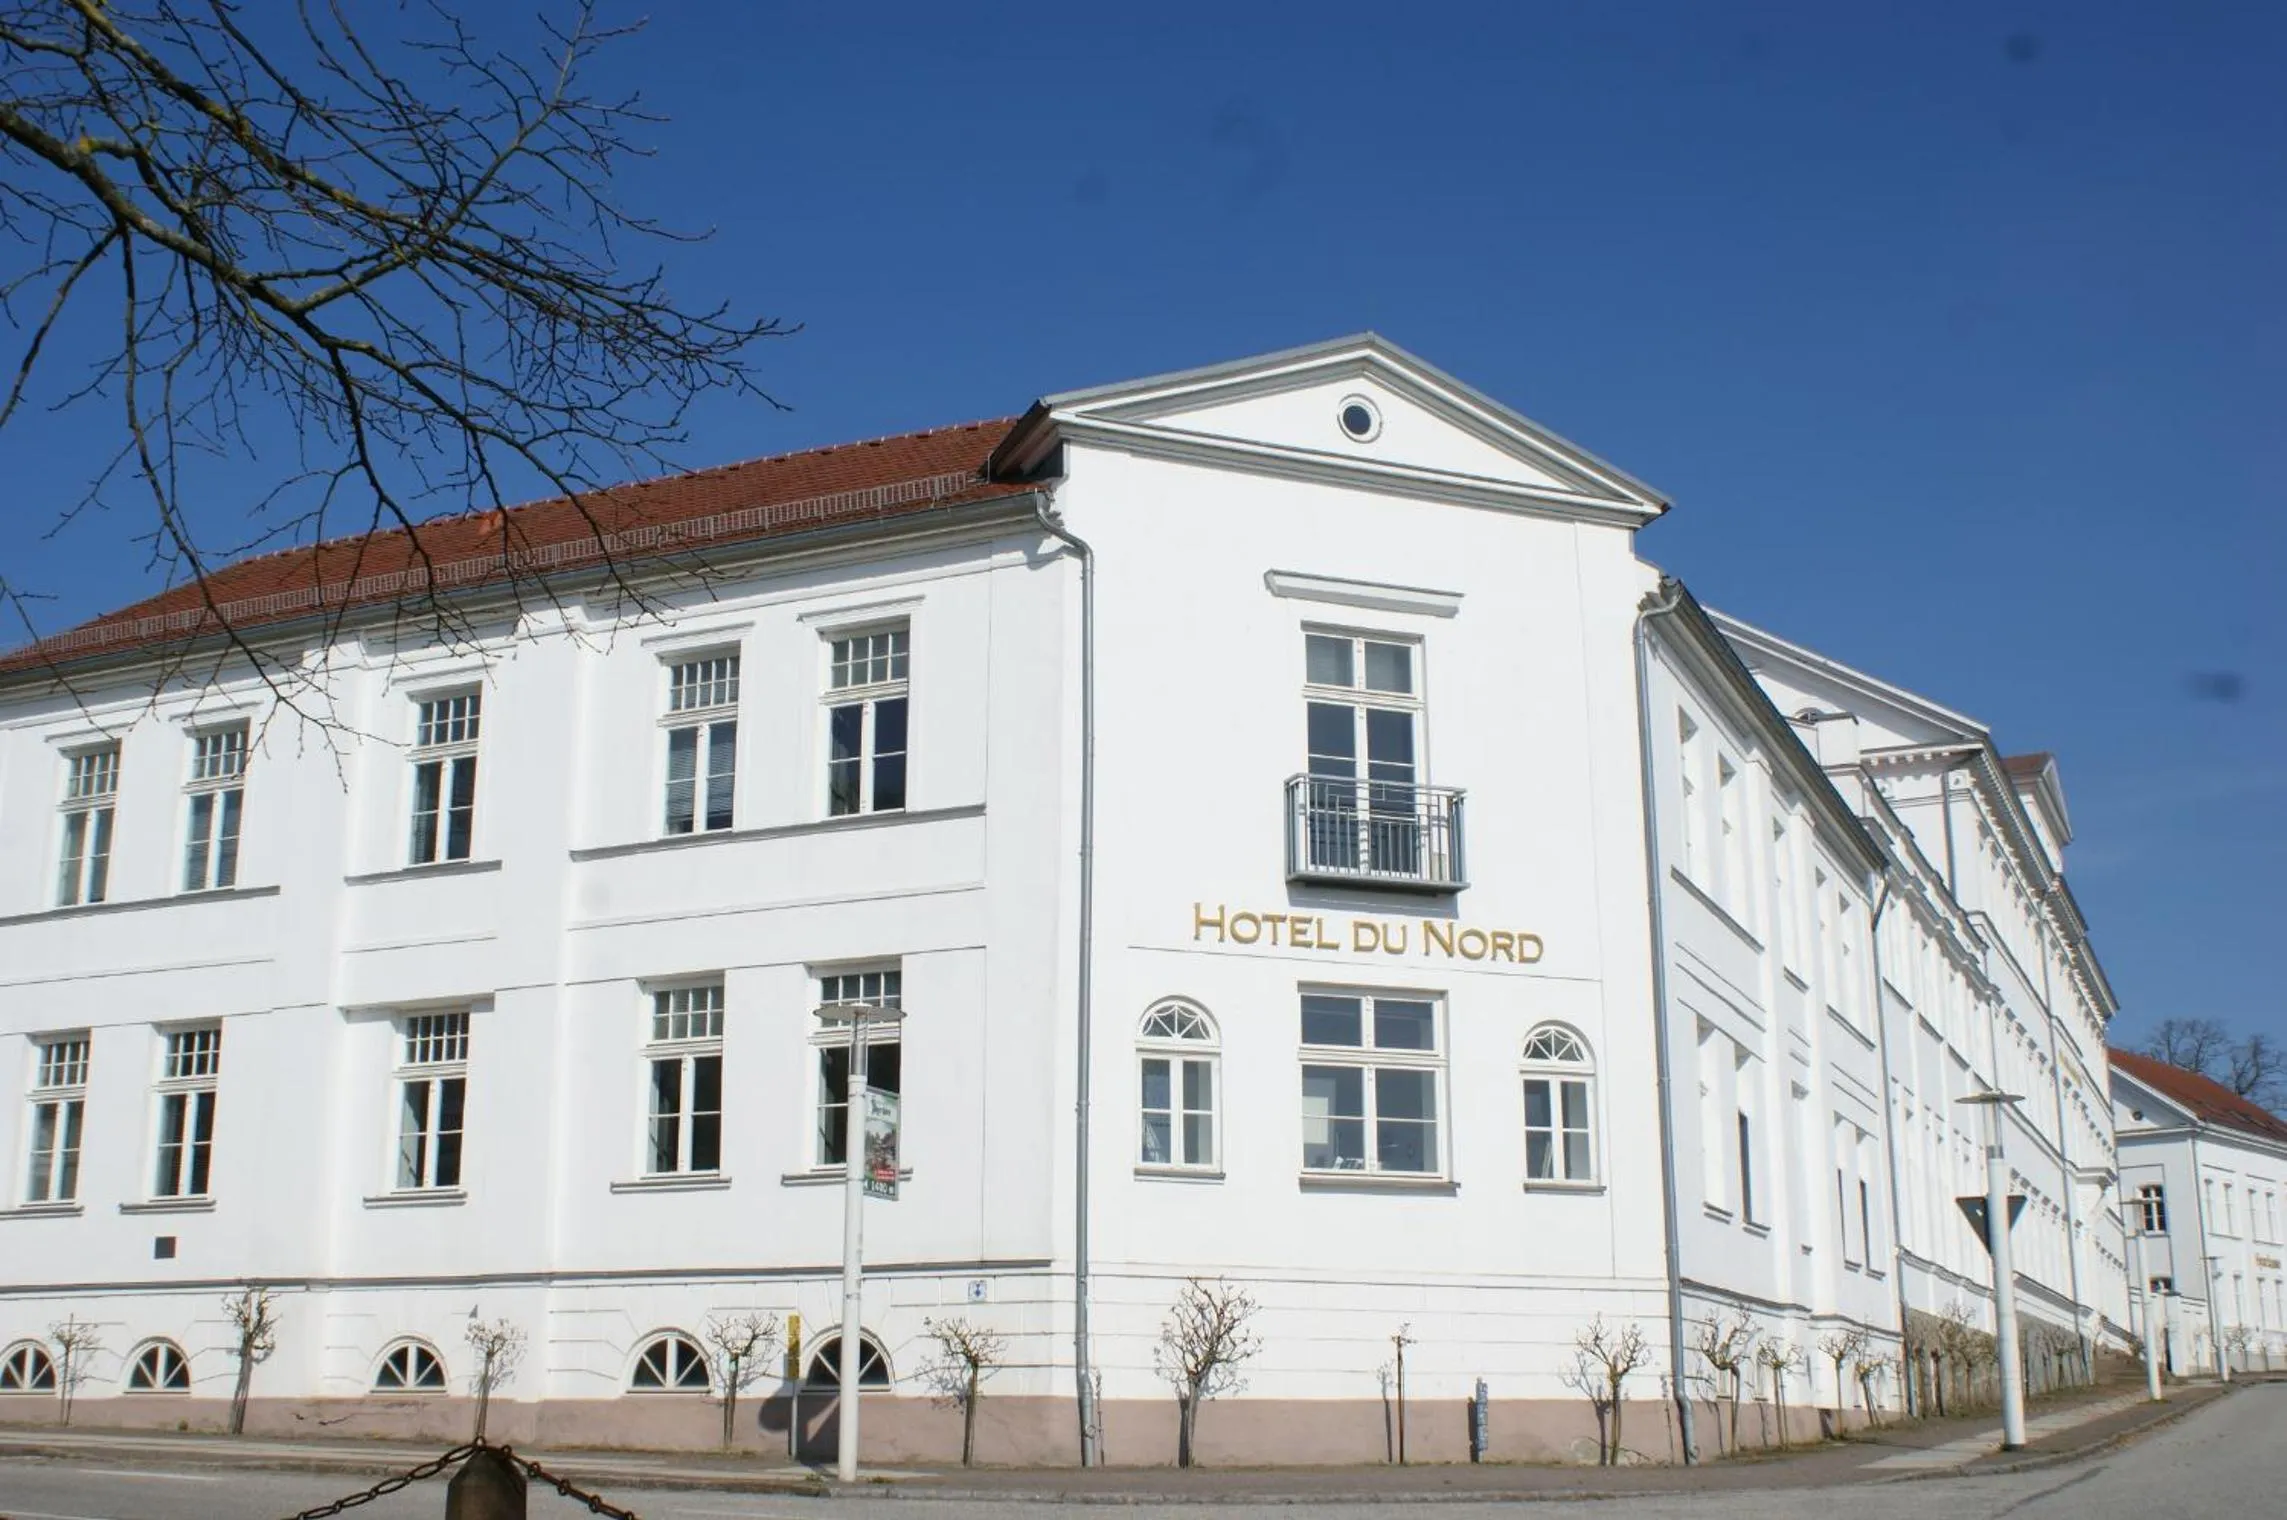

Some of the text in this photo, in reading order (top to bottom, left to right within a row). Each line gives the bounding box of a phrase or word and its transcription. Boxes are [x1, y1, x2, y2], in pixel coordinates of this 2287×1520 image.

[1193, 902, 1545, 965] HOTEL DU NORD
